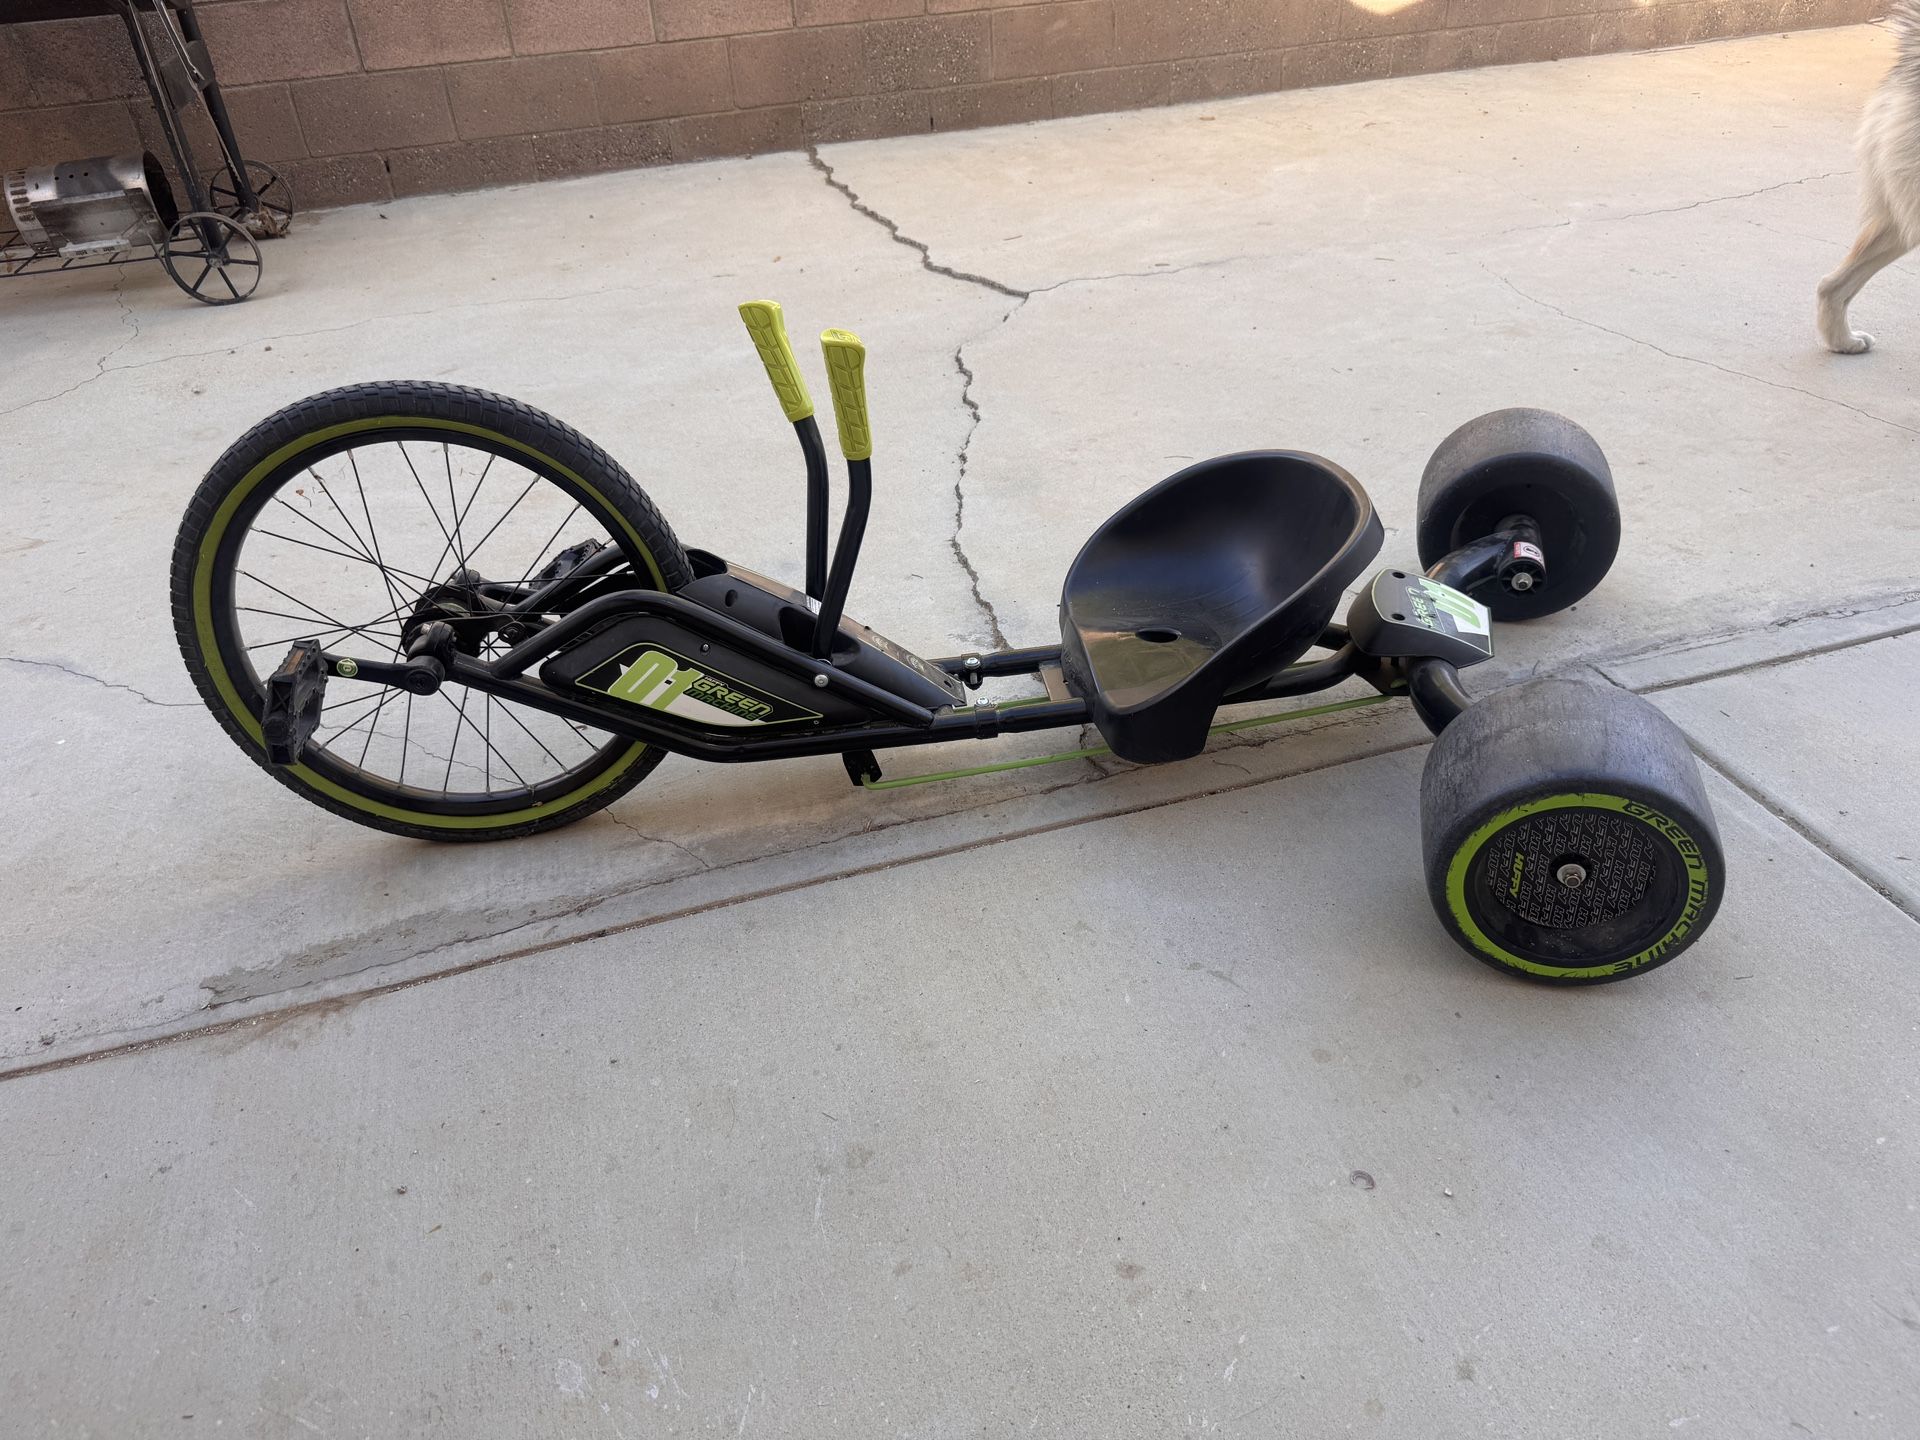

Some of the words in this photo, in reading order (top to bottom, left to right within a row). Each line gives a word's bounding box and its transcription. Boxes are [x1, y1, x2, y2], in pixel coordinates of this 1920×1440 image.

[686, 688, 760, 720] MACHINE
[693, 678, 771, 716] GREEN
[1622, 800, 1704, 870] GREEN
[1509, 851, 1525, 897] HUFFY
[1613, 879, 1707, 973] MACHINE
